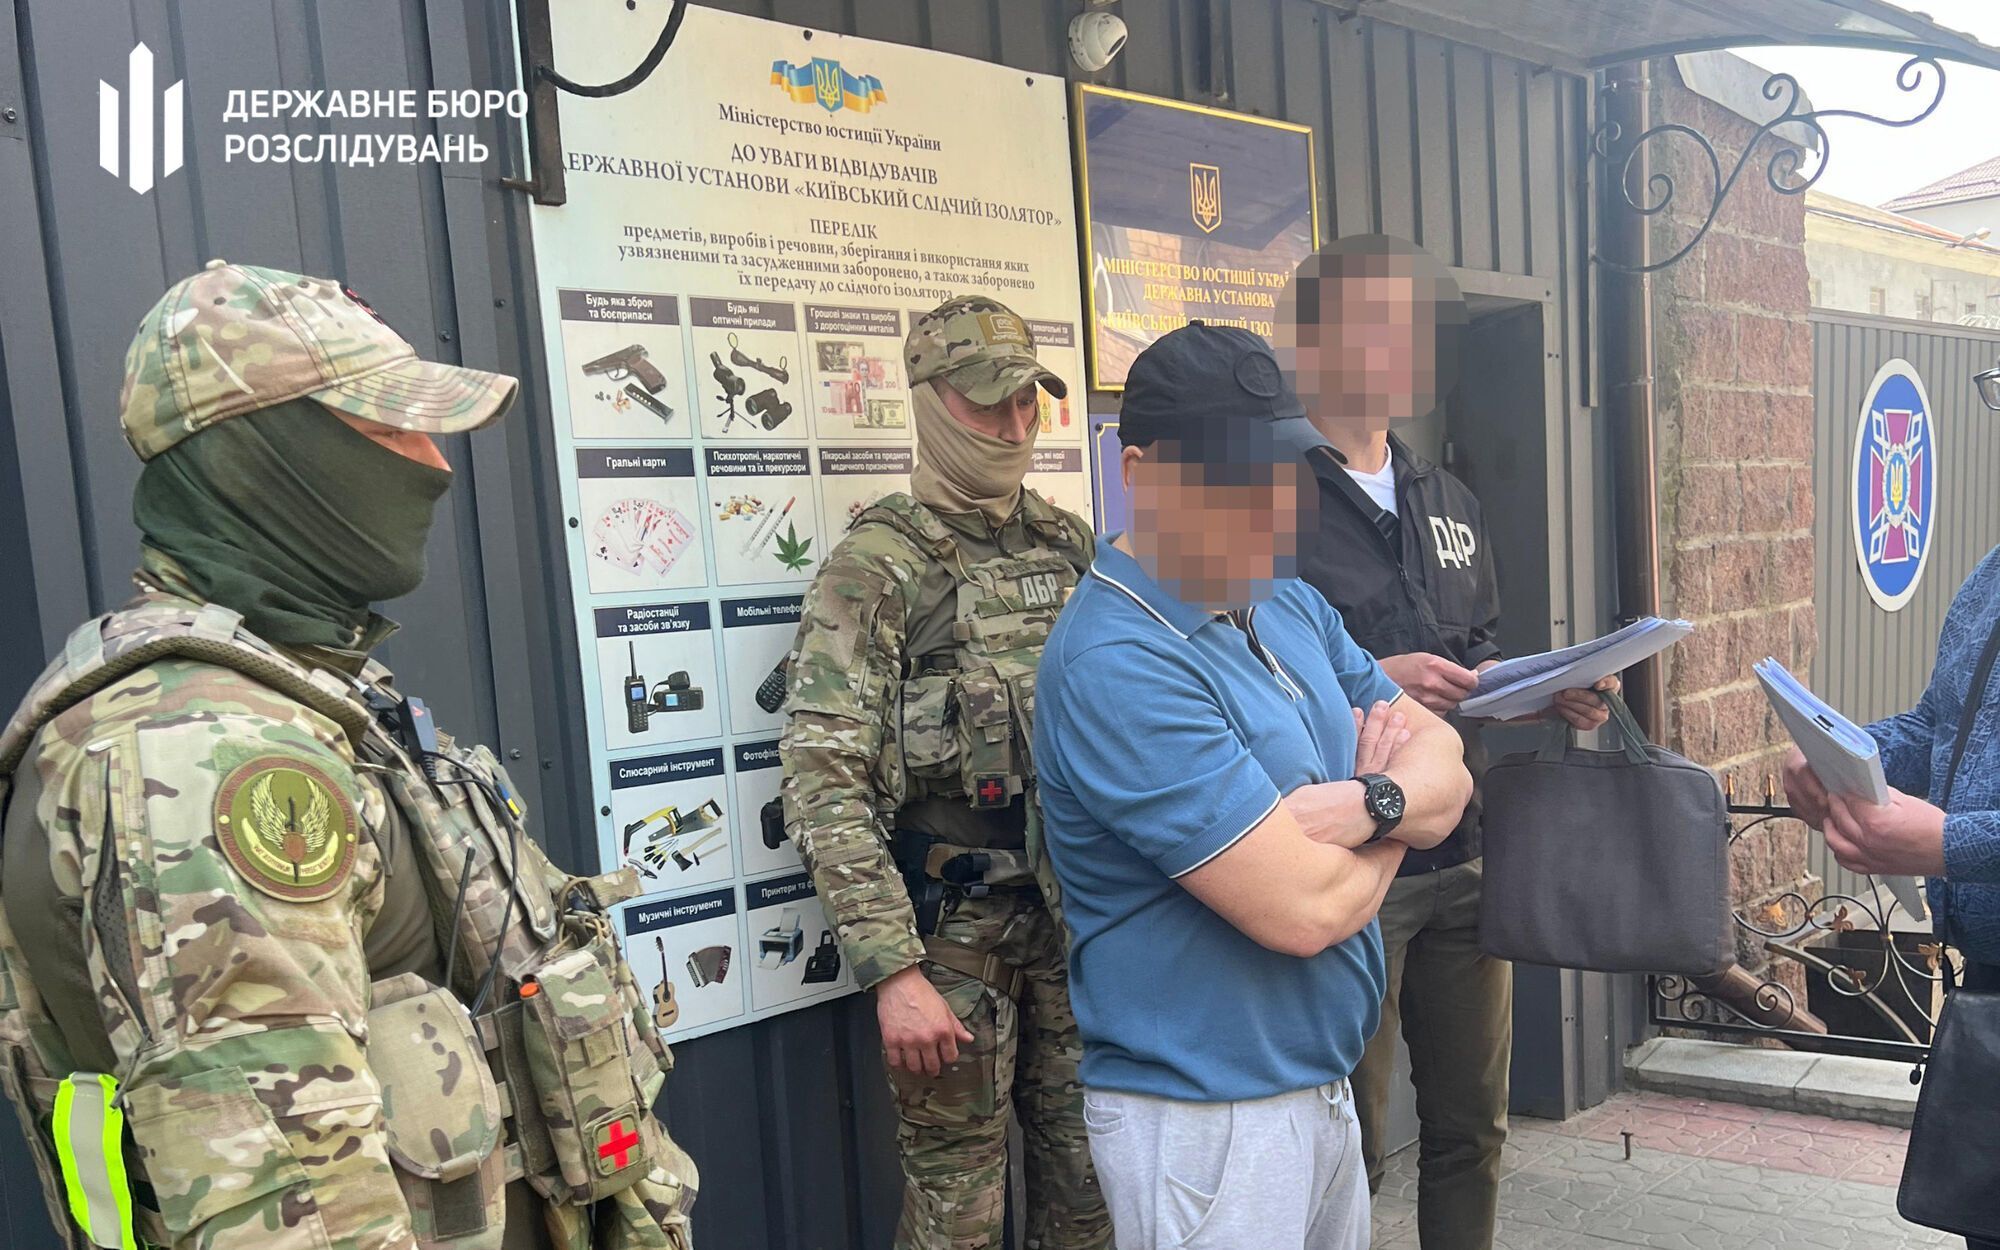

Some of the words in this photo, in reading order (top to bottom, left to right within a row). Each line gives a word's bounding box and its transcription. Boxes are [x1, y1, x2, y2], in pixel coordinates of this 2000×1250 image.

[719, 103, 822, 136] Міністерство
[826, 125, 883, 144] юстиції
[886, 129, 941, 151] України
[732, 143, 756, 163] ДО
[759, 146, 817, 170] УВАГИ
[822, 155, 938, 185] ВІДВІДУВАЧІВ
[563, 152, 683, 182] ЕРЖАВНОЇ
[686, 165, 790, 195] УСТАНОВИ
[794, 180, 909, 208] «КИЇВСЬКИЙ
[912, 194, 982, 217] СЛІДЧИЙ
[985, 202, 1062, 226] ІЗОЛЯТОР»
[810, 218, 878, 239] ПЕРЕЛІК
[624, 225, 707, 246] предметів,
[710, 232, 767, 249] виробів
[769, 235, 774, 248] і
[777, 239, 838, 257] речовин,
[840, 242, 911, 264] зберігання
[913, 248, 918, 262] і
[920, 252, 1002, 272] використання
[1004, 260, 1030, 273] яких
[617, 245, 720, 265] узвязненими
[723, 253, 738, 266] та
[741, 254, 840, 274] засудженними
[843, 261, 922, 283] заборонено,
[925, 270, 931, 281] а
[933, 271, 970, 285] також
[971, 272, 1035, 291] заборонено
[1104, 257, 1200, 281] МІНІСТЕРСТВО
[1202, 267, 1256, 287] ЮСТИЦІЇ
[737, 270, 751, 286] їх
[754, 273, 815, 294] передачу
[819, 279, 835, 292] до
[837, 277, 891, 297] слідчого
[893, 283, 953, 301] ізолятора
[1143, 283, 1211, 304] ДЕРЖАВНА
[1214, 289, 1275, 308] УСТАНОВА
[586, 294, 609, 307] Будь
[611, 297, 626, 306] яка
[627, 296, 653, 309] зброя
[727, 302, 748, 315] Будь
[588, 309, 599, 319] та
[601, 308, 653, 321] боєприпаси
[712, 315, 742, 326] оптичні
[743, 317, 776, 329] прилади
[606, 456, 640, 470] Гральні
[642, 458, 667, 469] карти
[748, 465, 756, 473] та
[1021, 573, 1059, 606] ДБР
[627, 606, 680, 620] Радіостанції
[737, 605, 771, 617] Мобільні
[772, 603, 802, 615] телефо
[617, 624, 628, 633] та
[629, 620, 659, 632] засоби
[661, 619, 690, 630] зв'язку
[619, 763, 669, 778] Слюсарний
[670, 758, 716, 772] інструмент
[761, 884, 797, 899] Принтери
[638, 907, 672, 924] Музичні
[673, 899, 723, 915] інструменти
